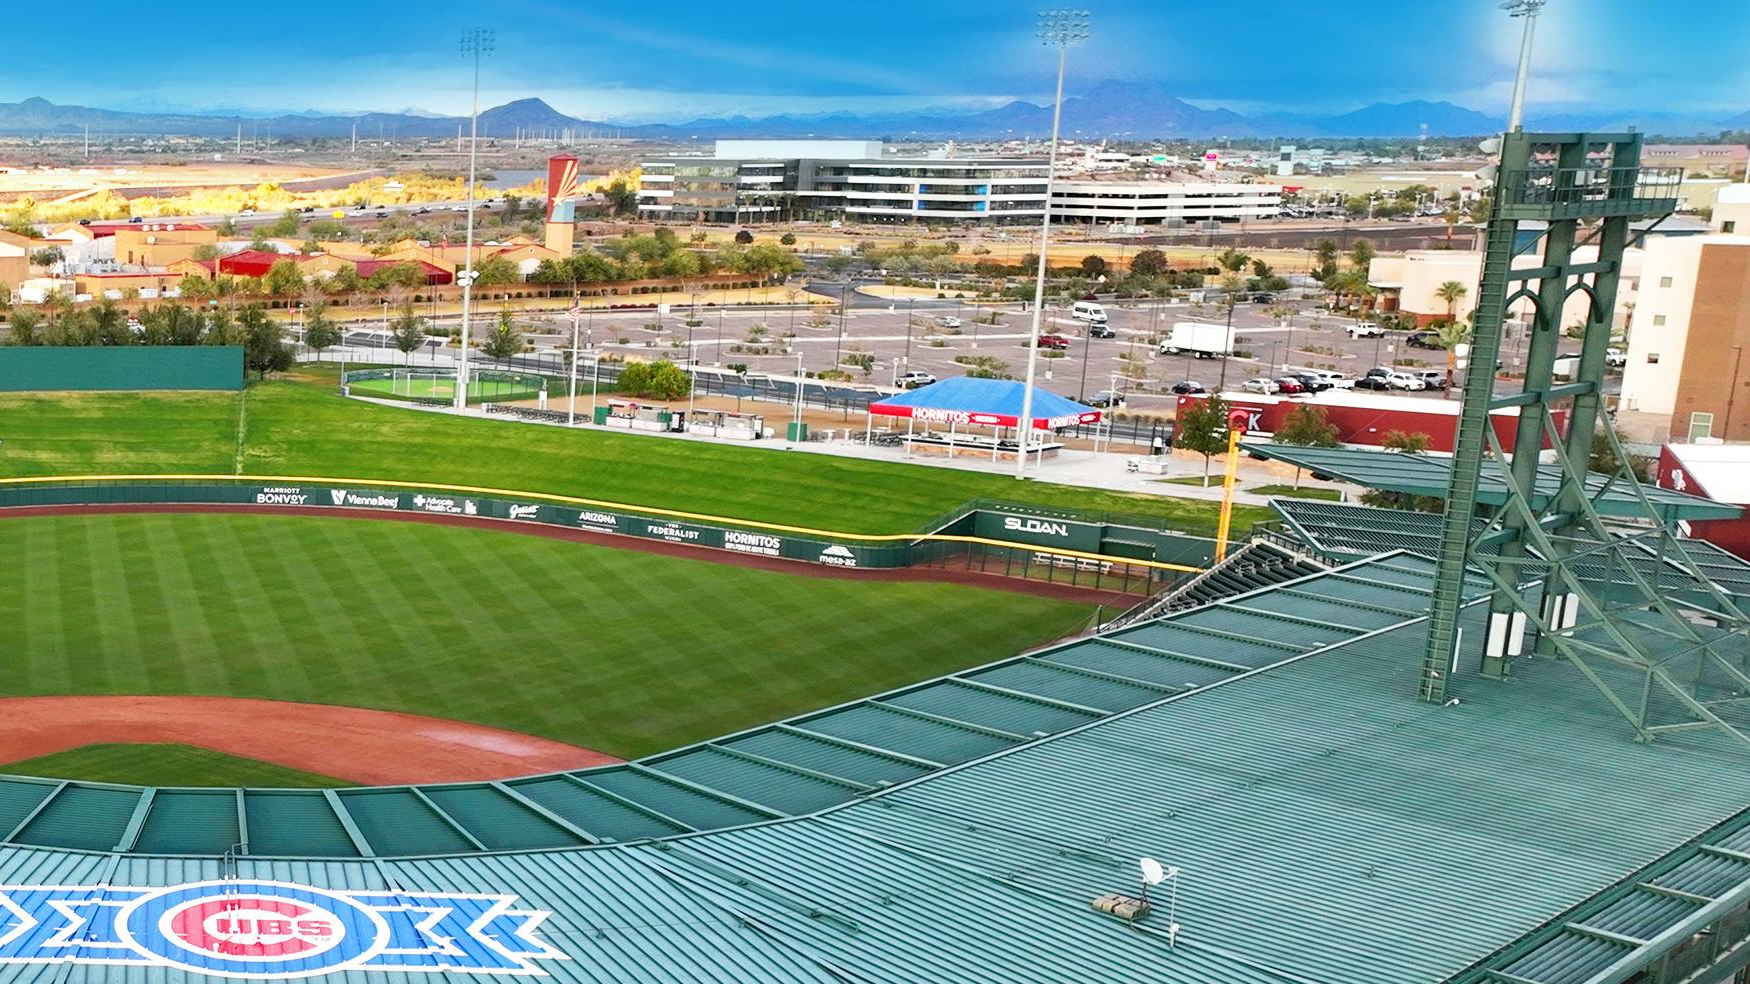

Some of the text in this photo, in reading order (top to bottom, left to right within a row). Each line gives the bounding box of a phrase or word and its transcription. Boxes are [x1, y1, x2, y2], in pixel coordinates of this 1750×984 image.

[912, 407, 971, 424] HORNITOS
[1048, 414, 1081, 429] HORNITOS
[257, 493, 308, 504] BONVOY
[347, 494, 399, 509] Vienna Beef
[579, 512, 617, 525] ARIZONA
[647, 525, 700, 540] FEDERALIST
[724, 531, 781, 549] HORNITOS
